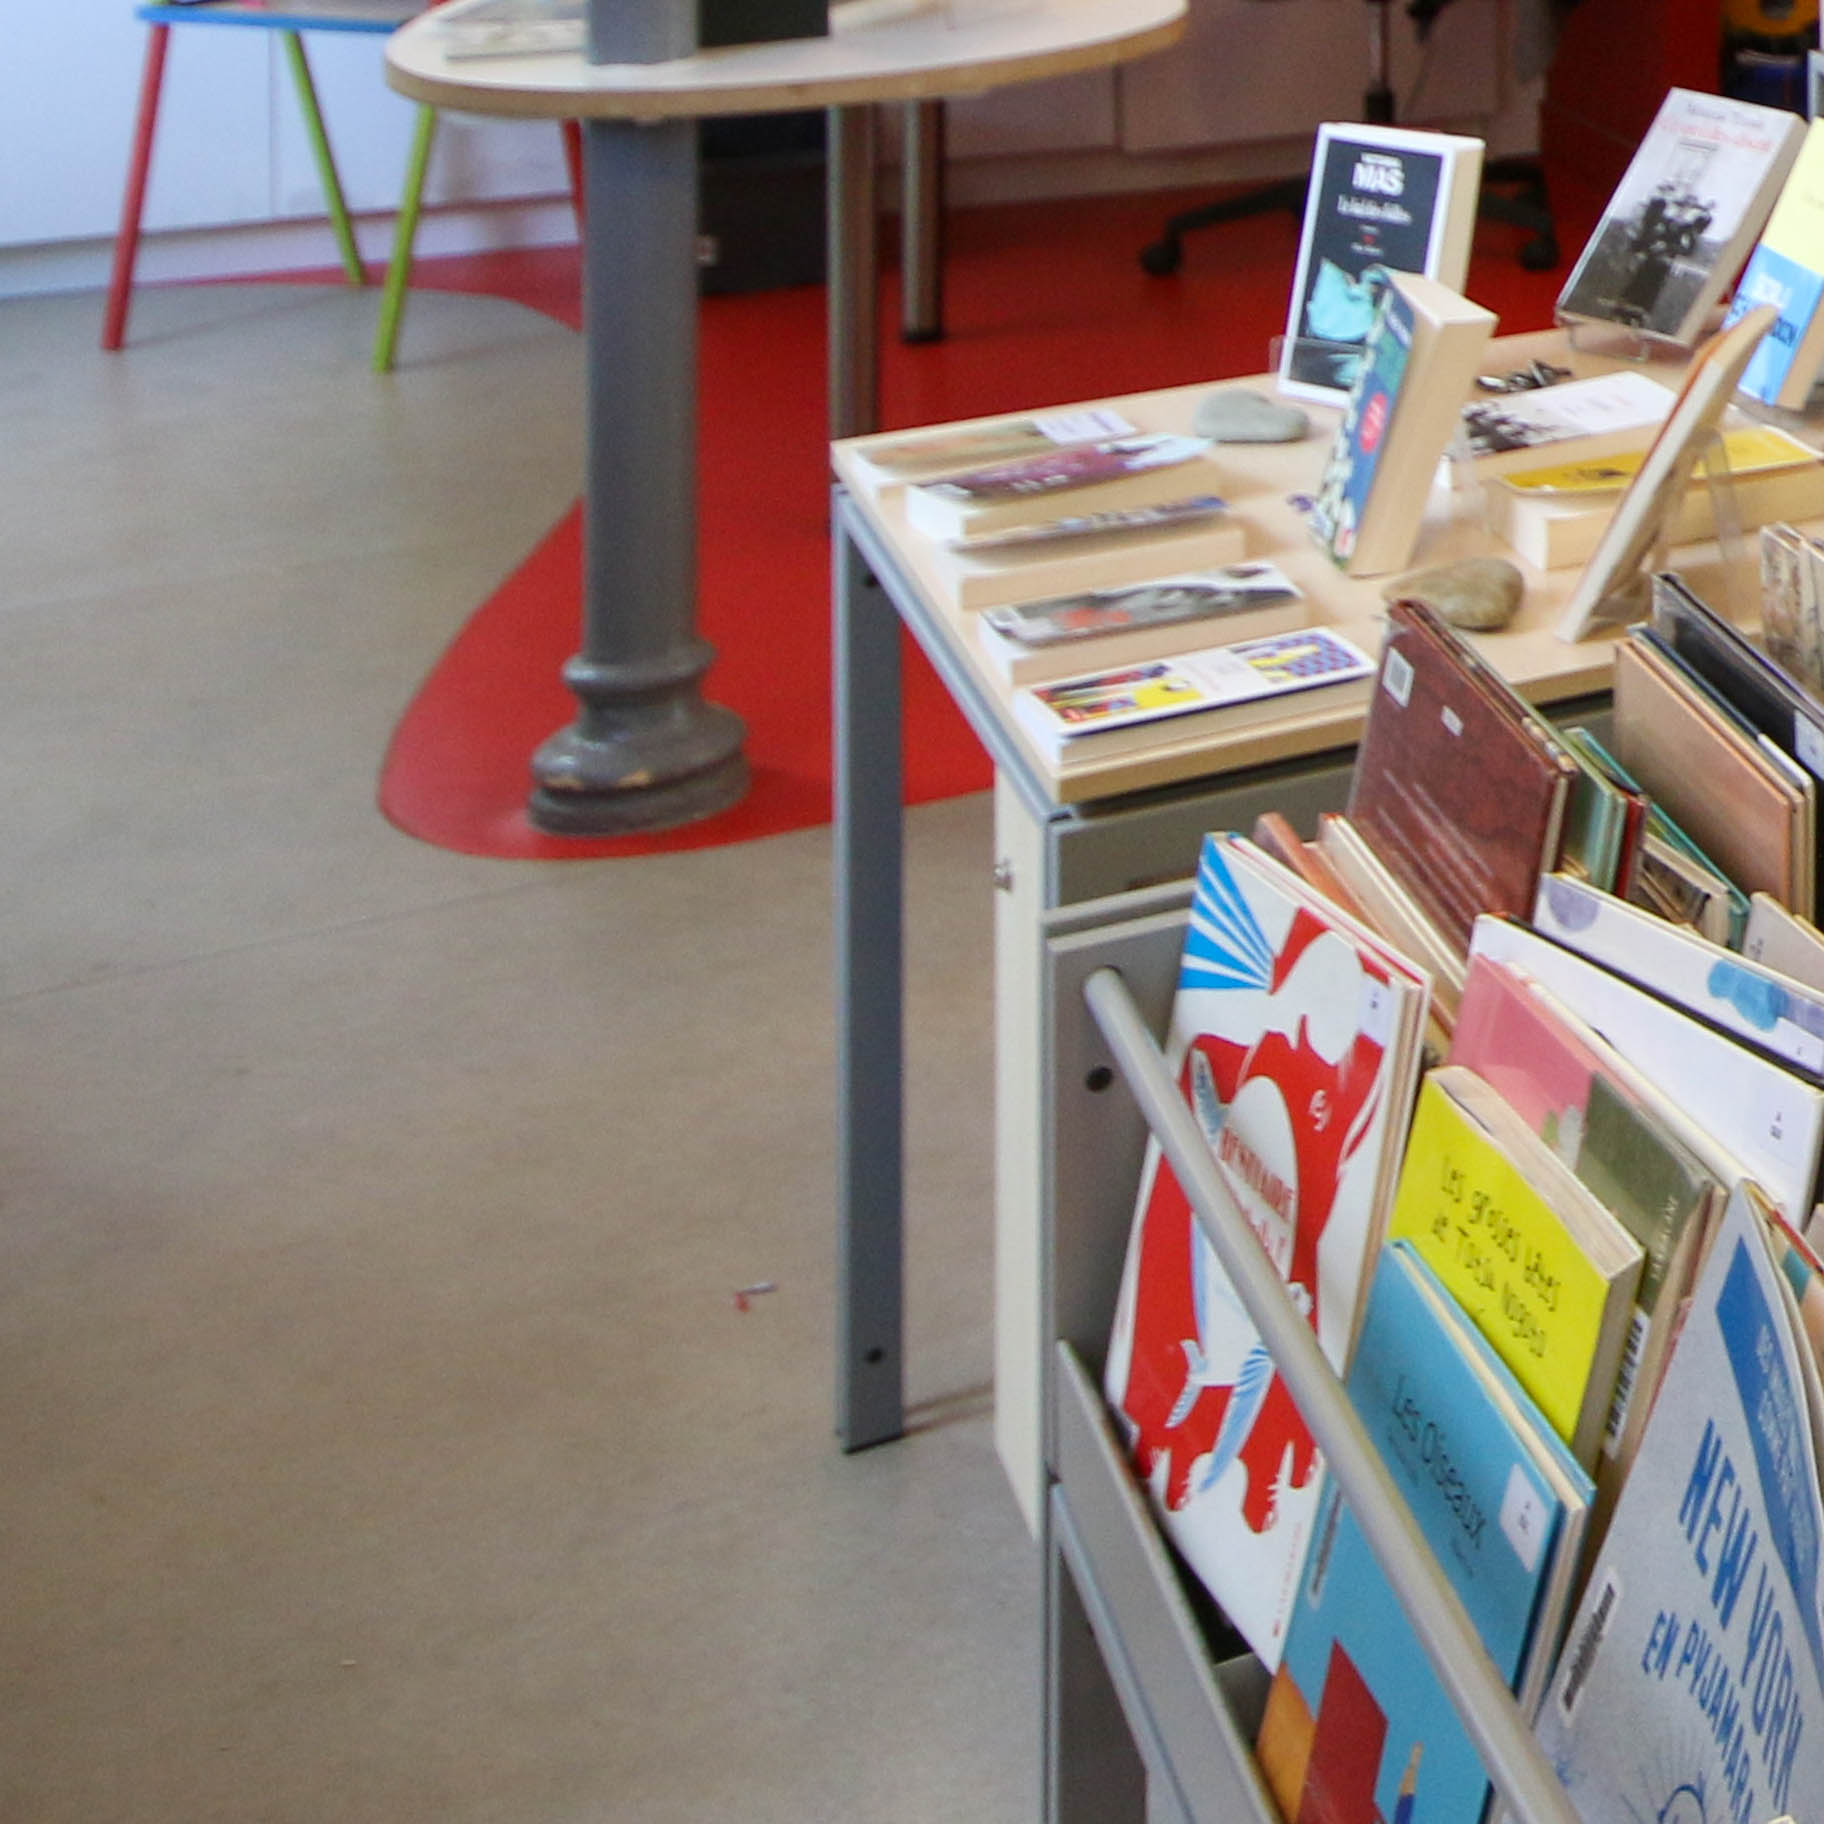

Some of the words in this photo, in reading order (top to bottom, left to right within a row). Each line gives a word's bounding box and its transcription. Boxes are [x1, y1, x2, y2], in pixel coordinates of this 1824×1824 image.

[1352, 161, 1404, 197] MAS
[1640, 1607, 1682, 1681] EN
[1677, 1415, 1759, 1632] NEW
[1740, 1558, 1804, 1816] YORK
